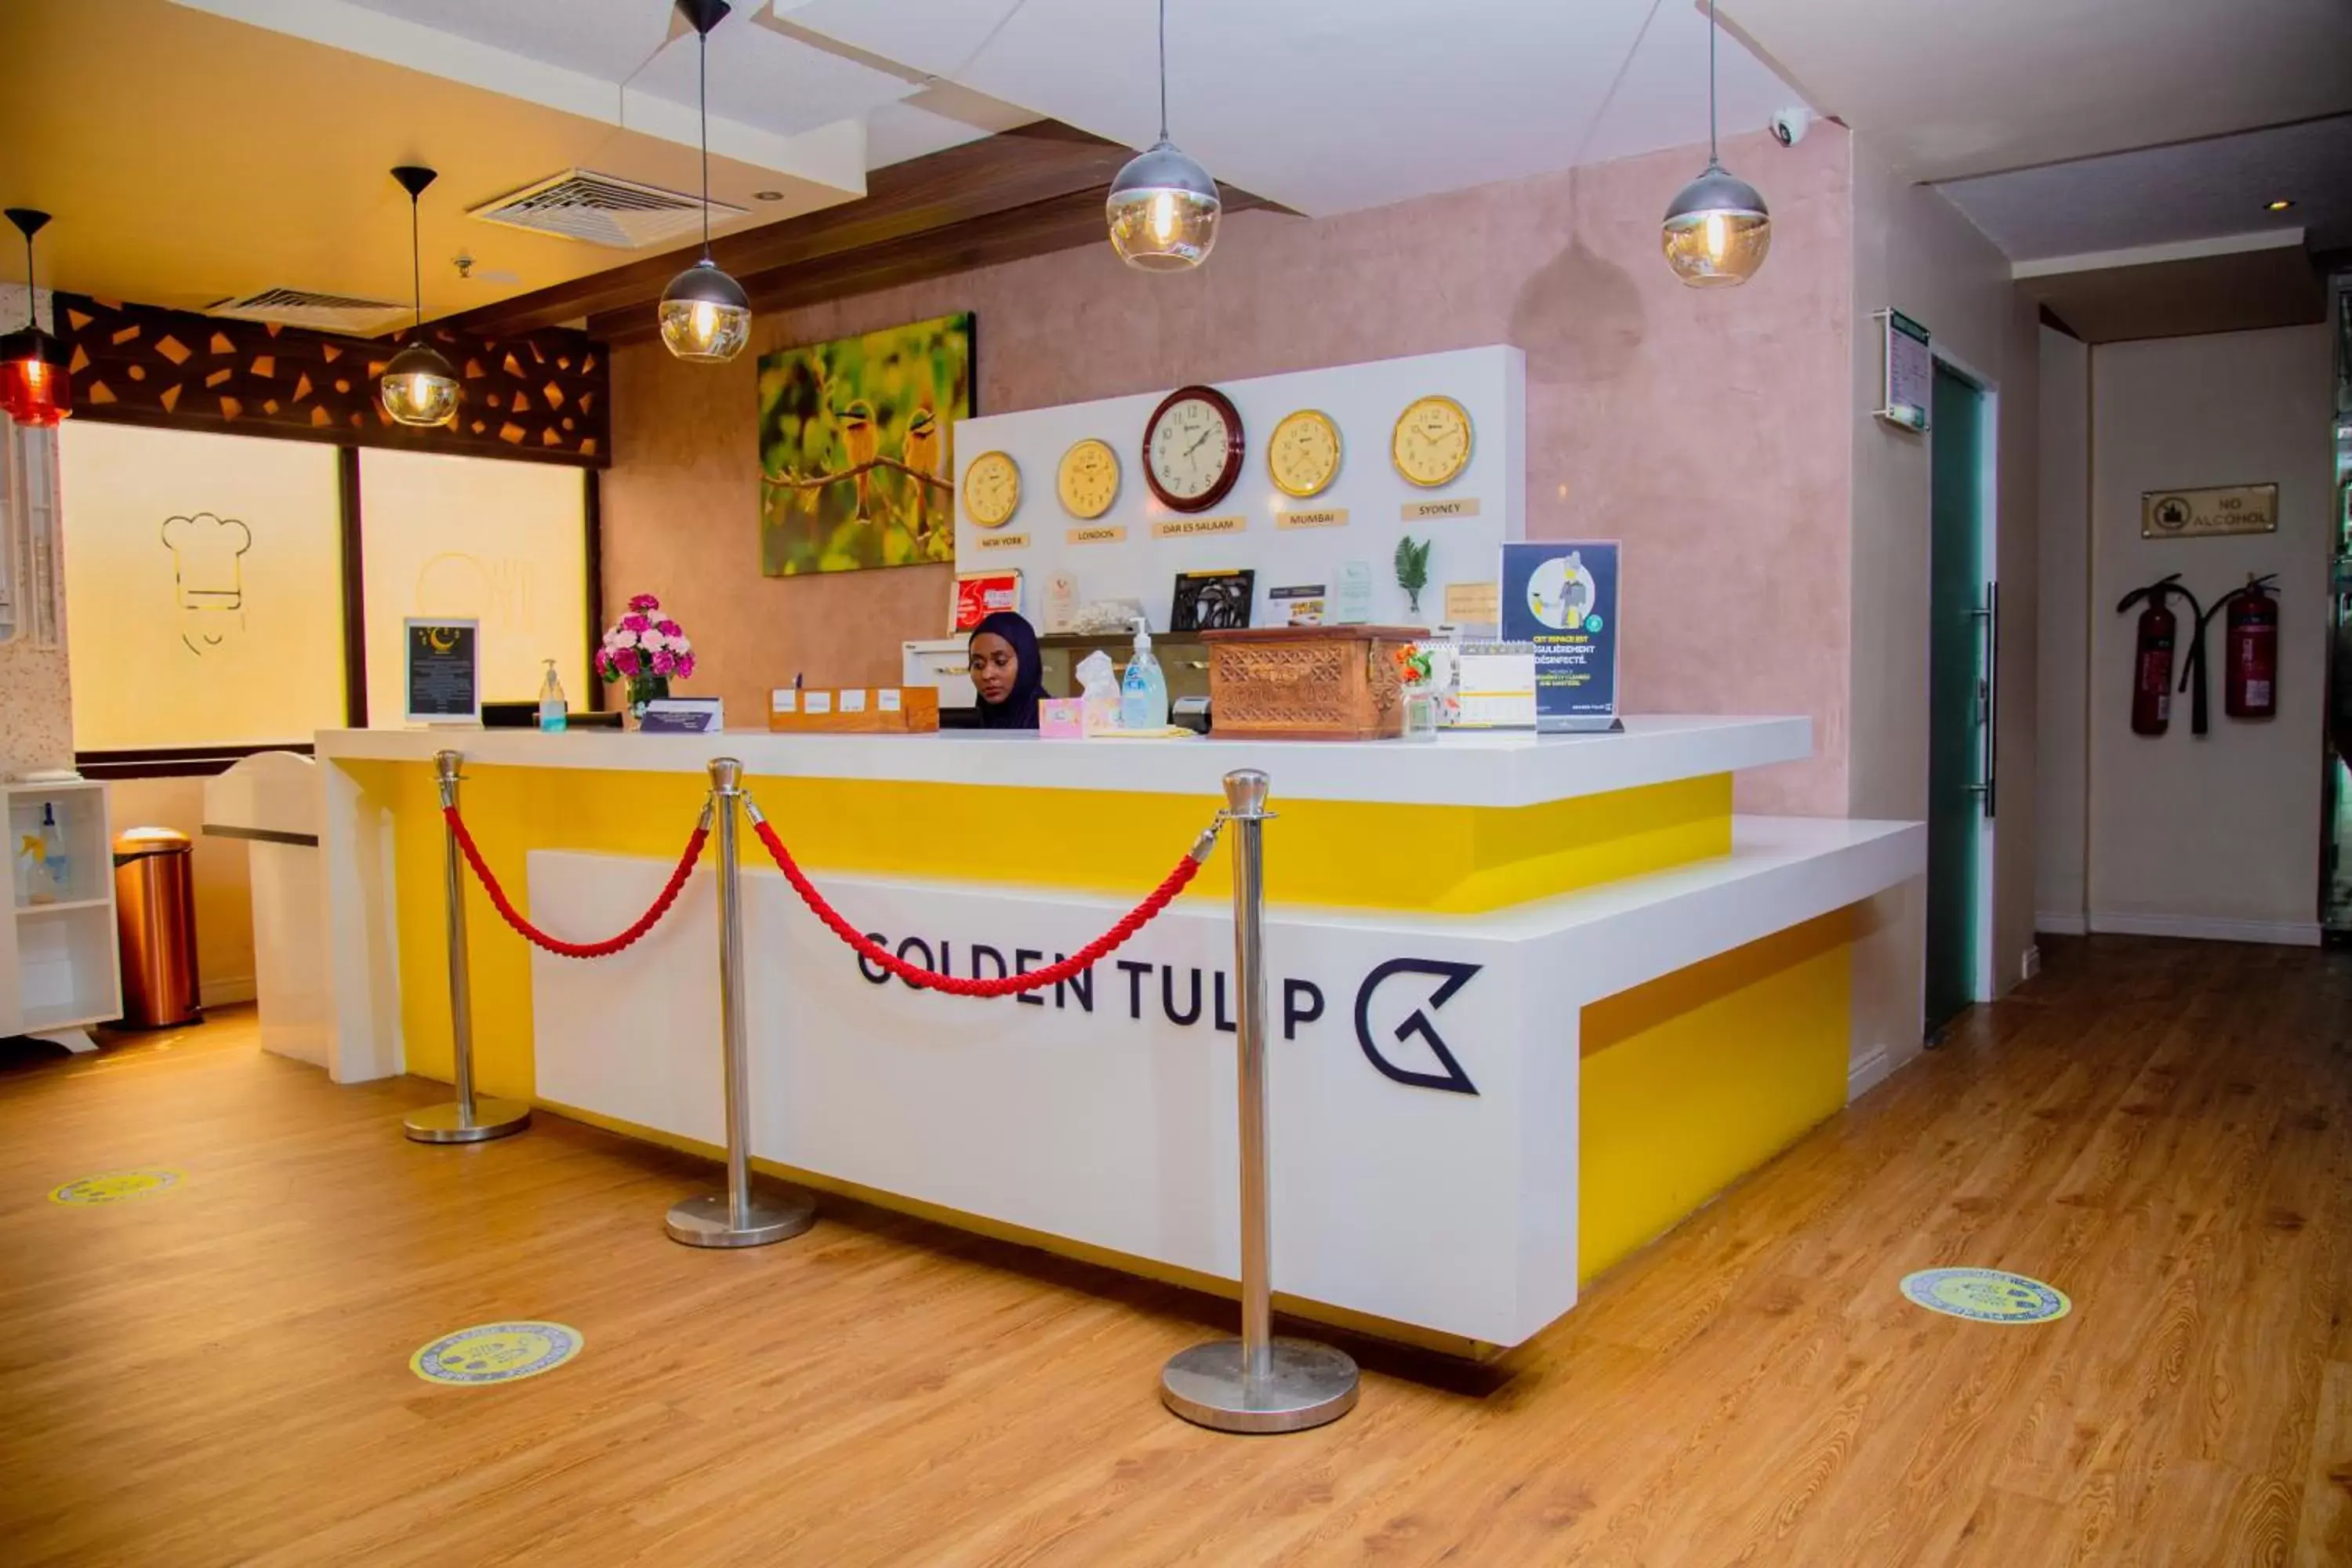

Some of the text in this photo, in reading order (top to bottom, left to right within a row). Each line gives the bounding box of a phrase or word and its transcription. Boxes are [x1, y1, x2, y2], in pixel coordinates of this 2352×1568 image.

[1188, 405, 1197, 418] 12
[1205, 474, 1212, 487] 5
[1419, 503, 1461, 515] SYDNEY
[2219, 497, 2242, 510] NO
[1290, 514, 1334, 524] MUMBAI
[2193, 512, 2267, 527] ALCOHOL
[1163, 521, 1234, 534] DAR ES SALAAM
[1078, 530, 1114, 540] LONDON
[982, 537, 1022, 547] NEW YORK
[858, 932, 1325, 1040] GOLDEN TULP
